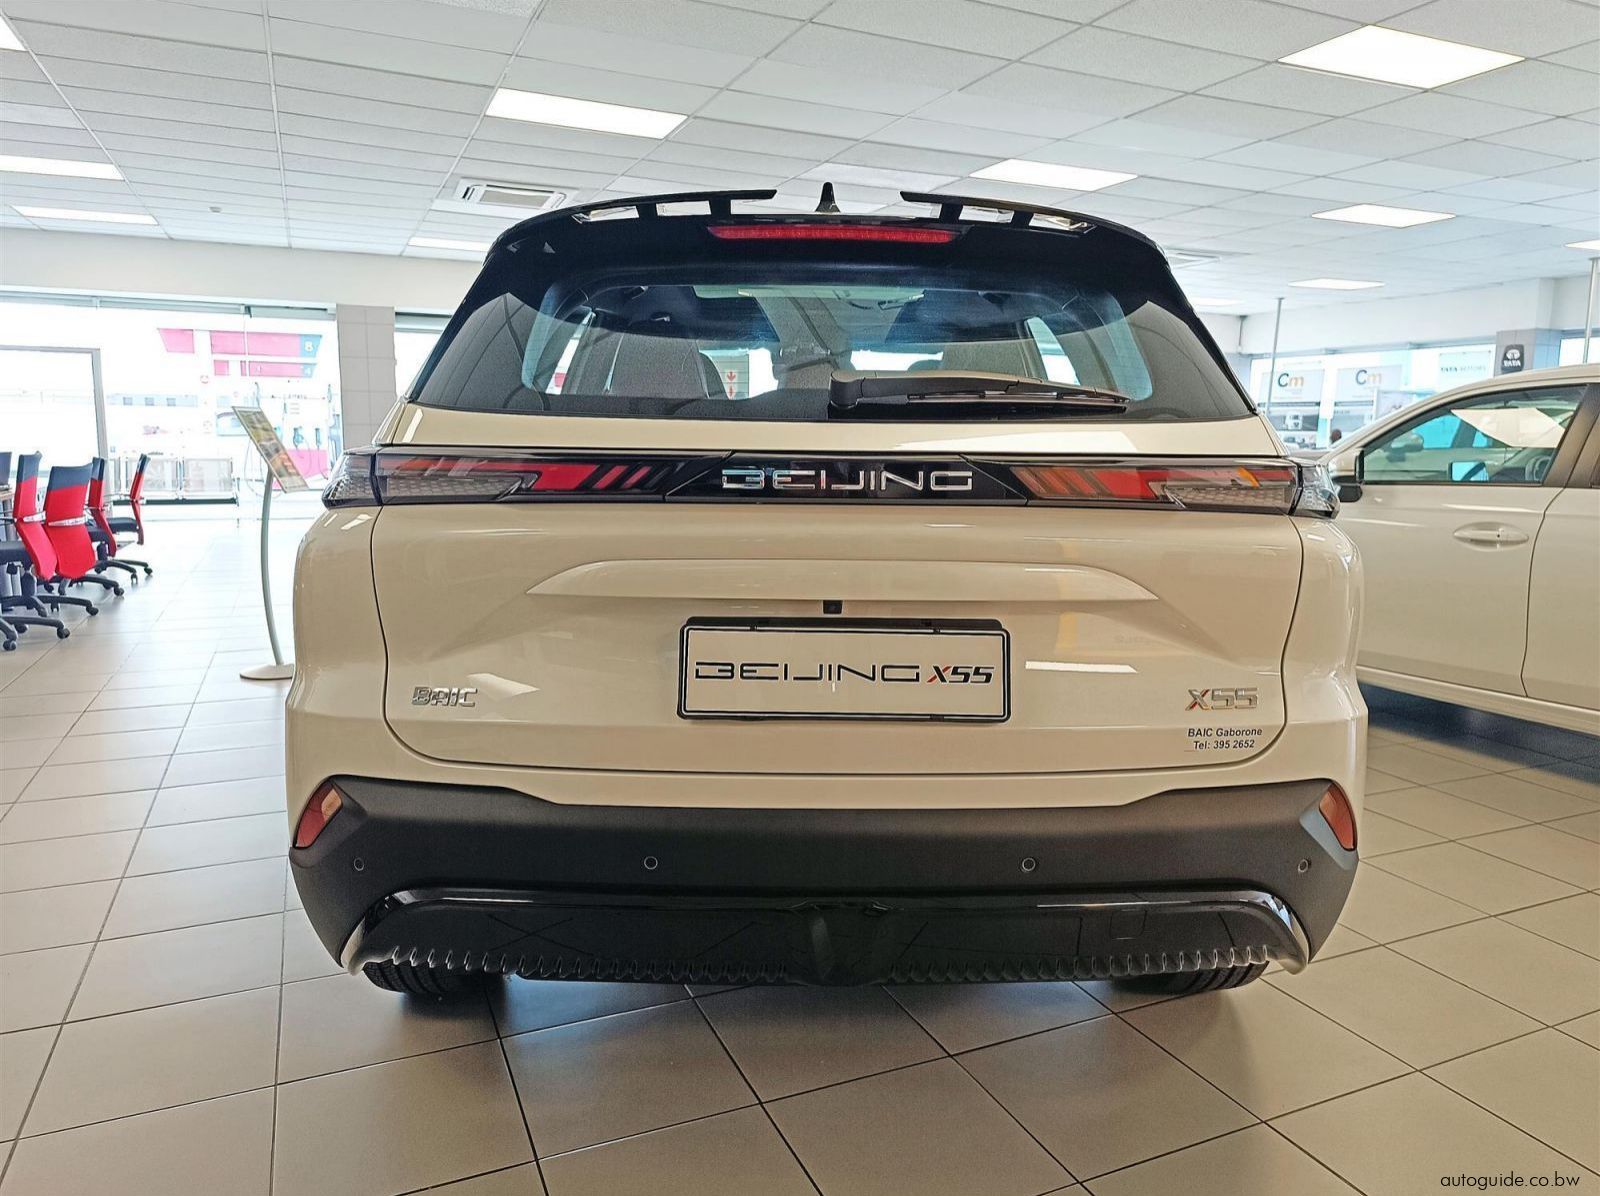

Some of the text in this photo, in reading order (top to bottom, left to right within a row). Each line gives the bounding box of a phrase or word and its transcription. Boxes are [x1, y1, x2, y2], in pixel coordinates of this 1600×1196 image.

[1277, 372, 1305, 388] Cm
[1355, 369, 1382, 385] Cm
[722, 469, 973, 491] BEIJING
[695, 661, 995, 684] BEIJING X55
[411, 686, 478, 707] BAIC
[1185, 687, 1258, 711] X55
[1188, 727, 1263, 738] BAIC Gaborone
[1193, 739, 1255, 750] Tel: 395 2652
